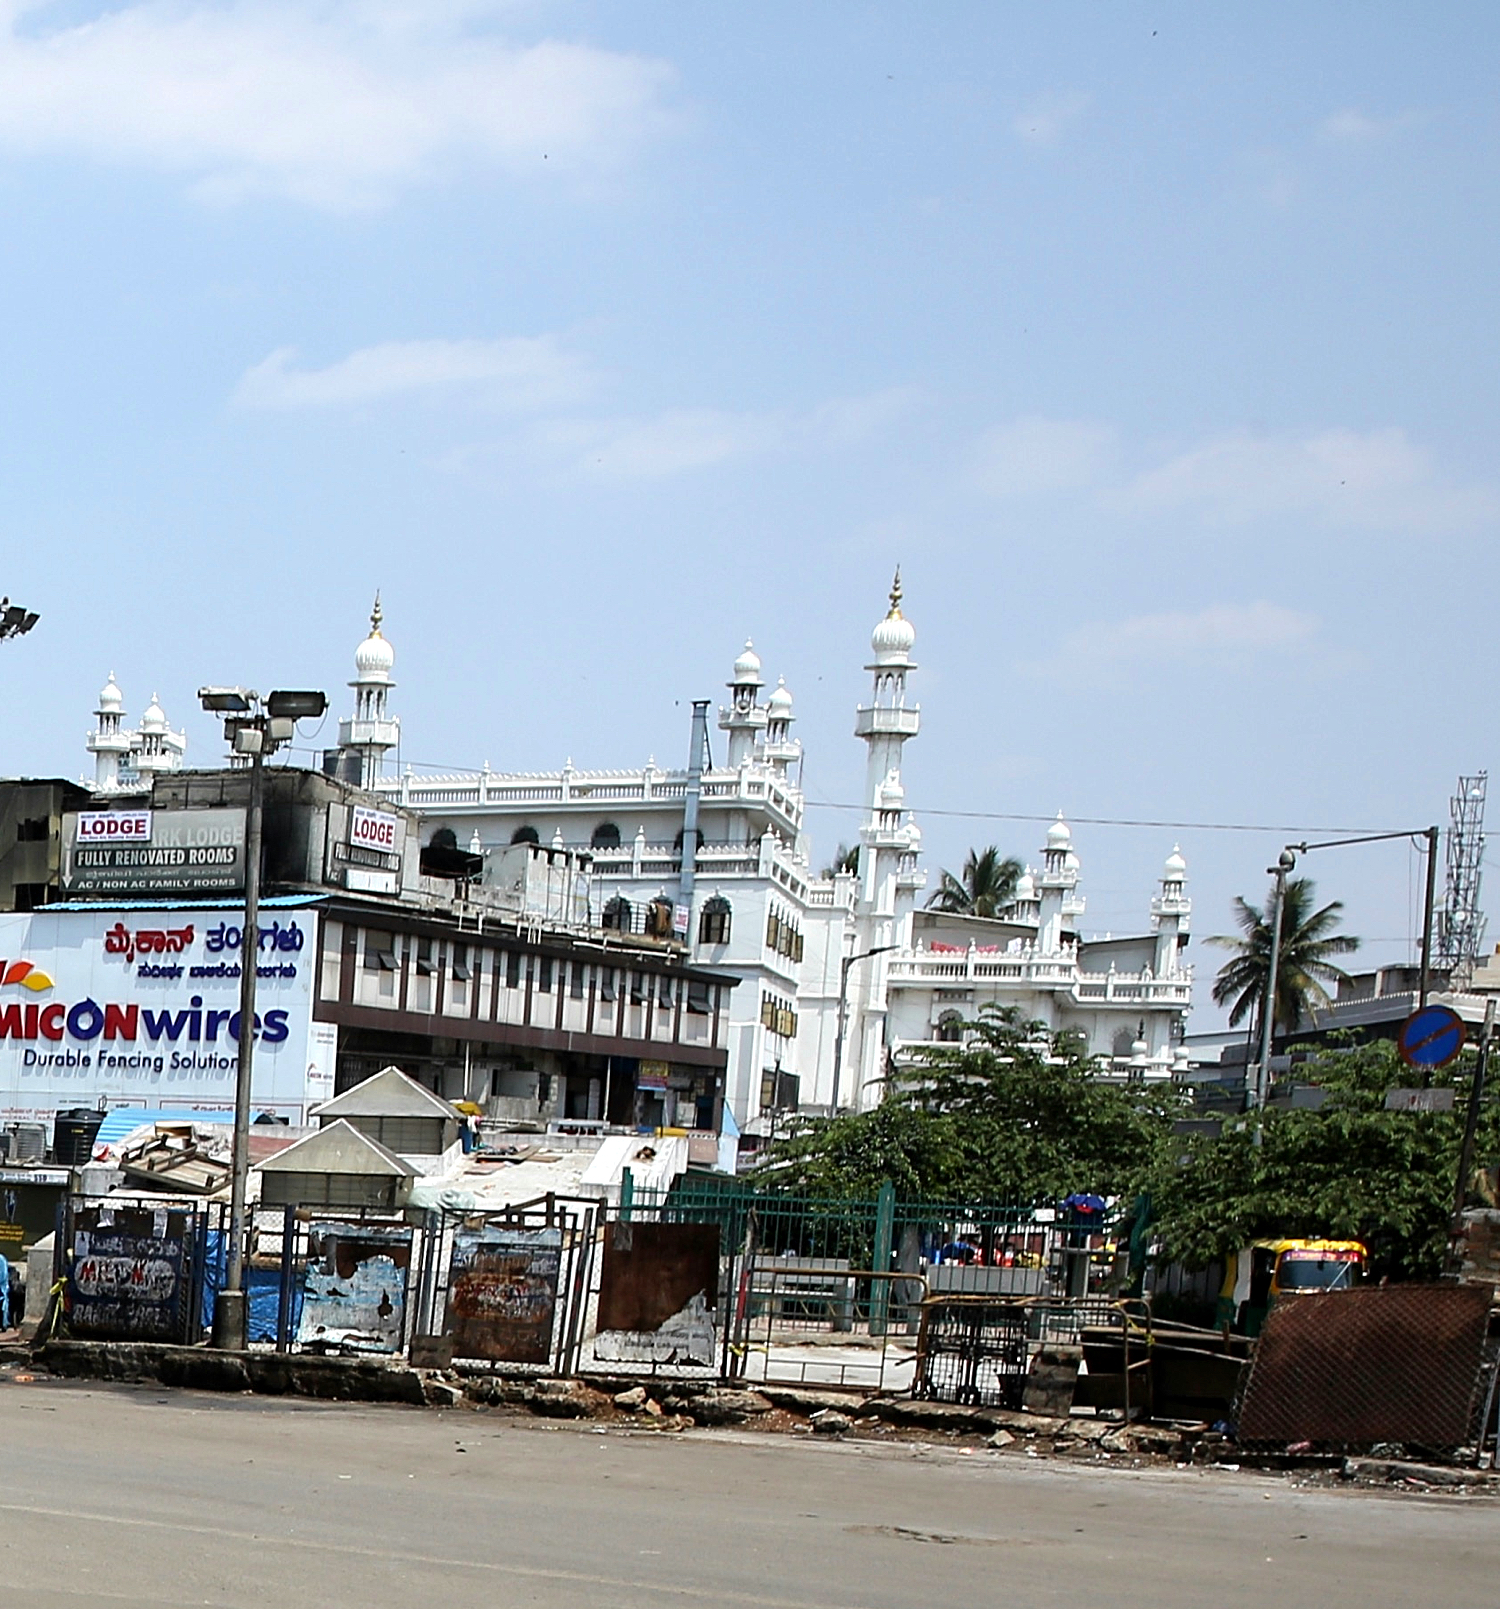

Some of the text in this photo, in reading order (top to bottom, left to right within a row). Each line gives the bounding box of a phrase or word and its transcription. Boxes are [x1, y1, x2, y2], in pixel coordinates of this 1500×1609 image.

[80, 819, 147, 836] LODGE
[146, 826, 243, 848] ARK LODGE
[353, 816, 394, 845] LODGE
[77, 848, 235, 867] FULLY RENOVATED ROOMS
[78, 881, 94, 889] AC
[103, 880, 128, 889] NON
[130, 880, 146, 888] AC
[149, 879, 190, 888] FAMILY
[193, 878, 236, 887] ROOMS
[104, 922, 194, 963] ಮೈಕಾನ್
[141, 995, 290, 1044] wires
[23, 1049, 91, 1068] Durable
[98, 1052, 164, 1073] Fencing
